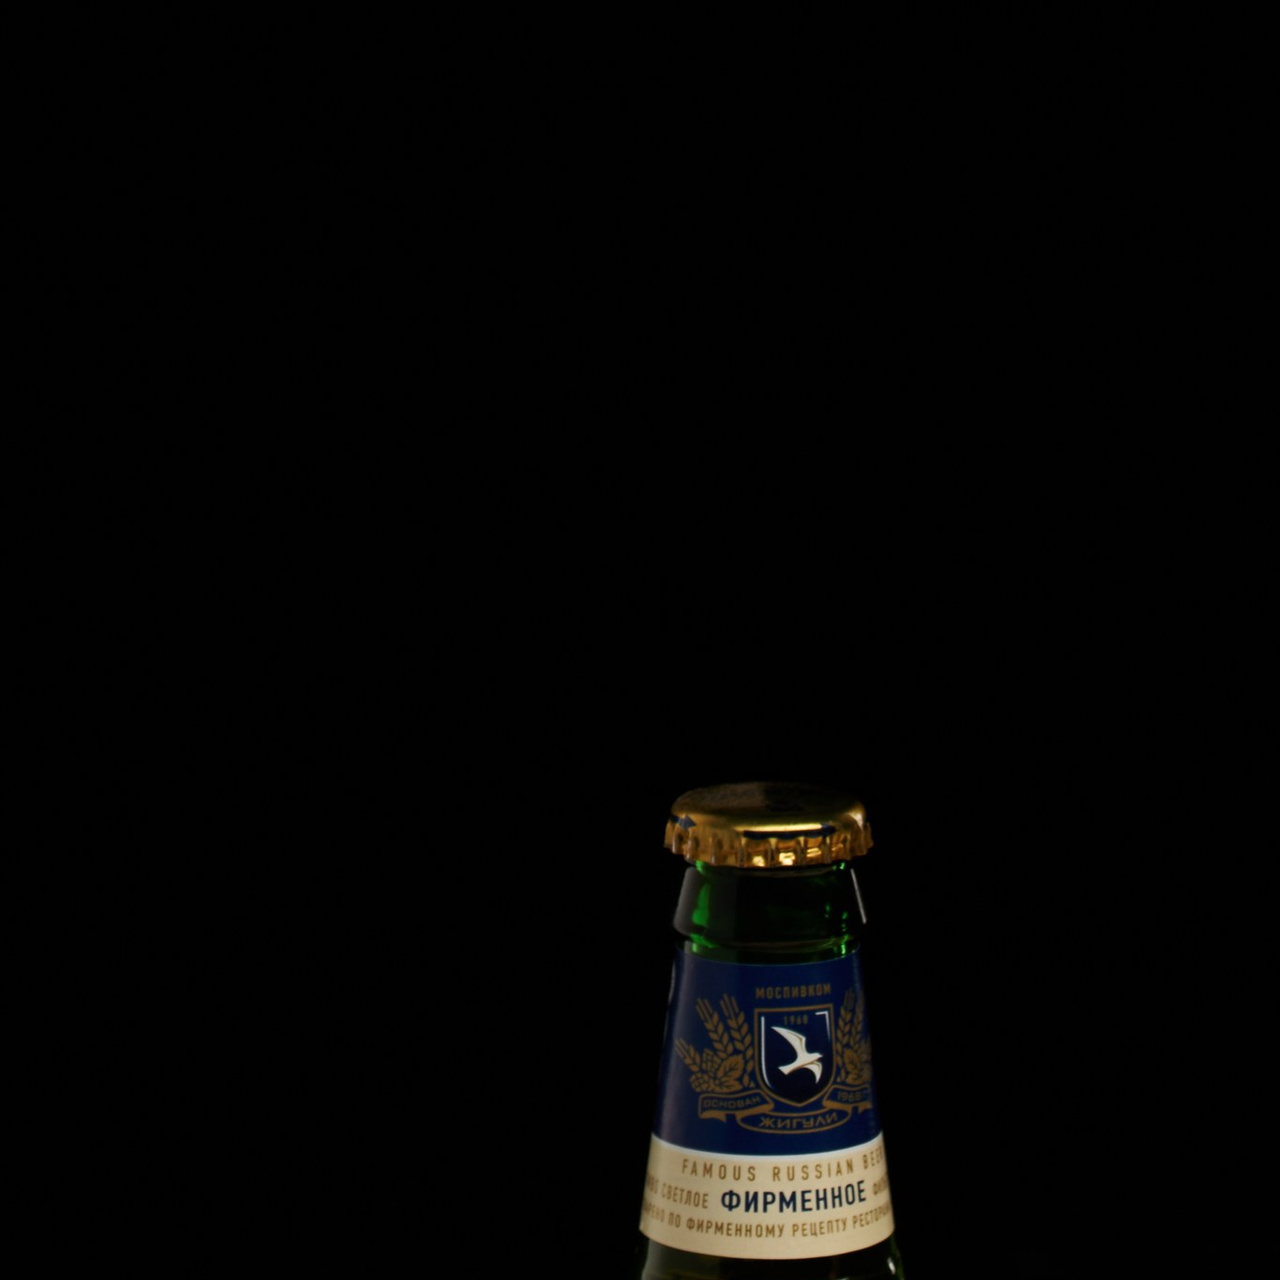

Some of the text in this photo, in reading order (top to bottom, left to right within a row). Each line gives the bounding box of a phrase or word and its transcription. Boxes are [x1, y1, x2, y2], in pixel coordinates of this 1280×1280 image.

[756, 983, 831, 999] МОСПИВКОМ
[759, 1112, 838, 1129] ЖИГУЛИ
[681, 1158, 756, 1182] FAMOUS
[772, 1159, 854, 1182] RUSSIAN
[661, 1181, 709, 1209] СВЕТЛОЕ
[720, 1179, 867, 1213] ФИРМЕННОЕ
[668, 1209, 681, 1228] ПО
[686, 1217, 785, 1238] ФИРМЕННОМУ
[792, 1217, 848, 1239] РЕЦЕПТУ
